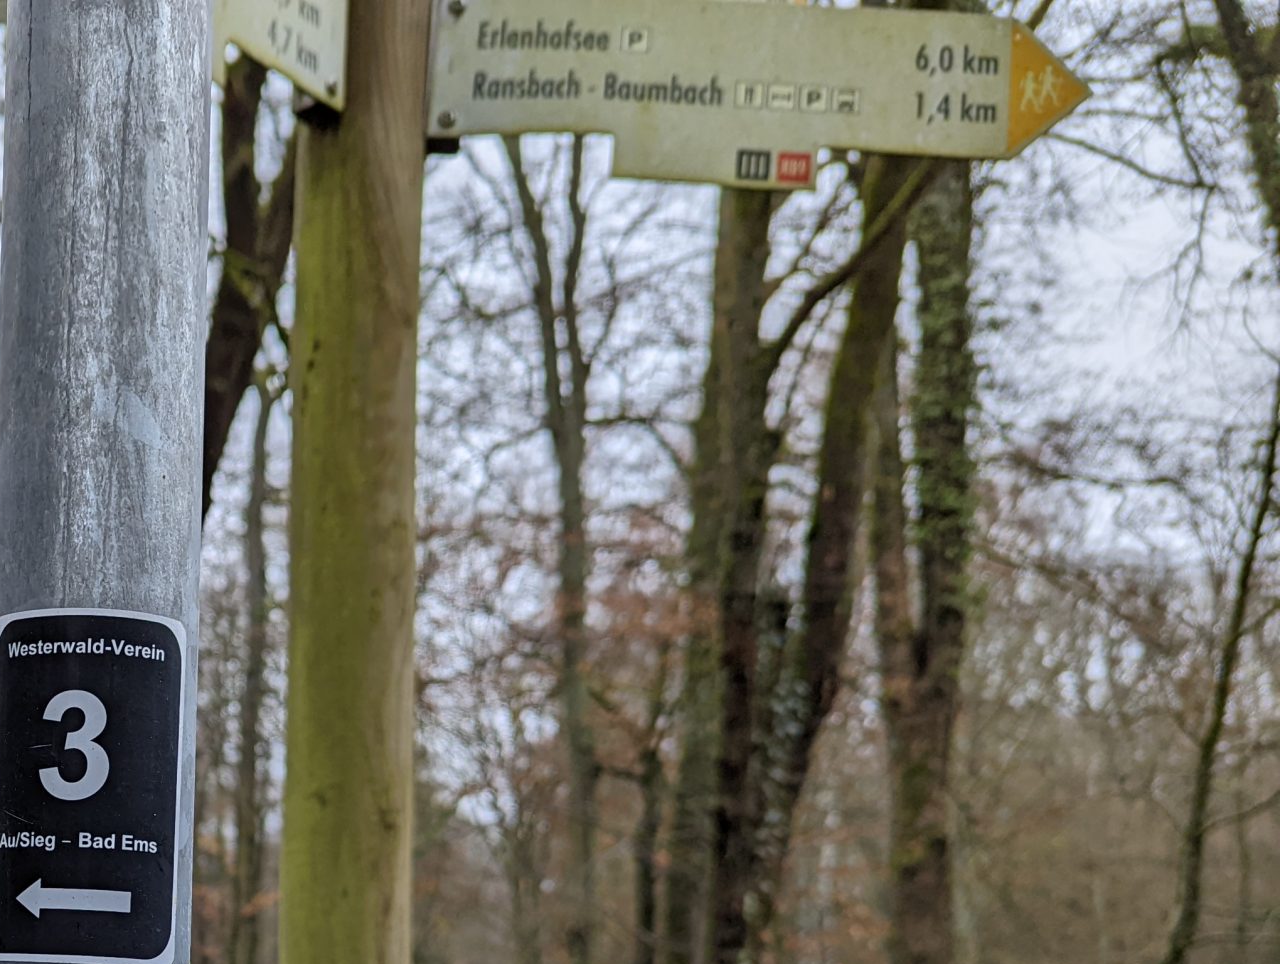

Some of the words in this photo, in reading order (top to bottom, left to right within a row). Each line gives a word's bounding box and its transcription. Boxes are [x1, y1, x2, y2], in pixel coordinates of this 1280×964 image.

[296, 33, 318, 73] km
[476, 20, 610, 53] Erlenhofsee
[914, 45, 956, 76] 6,0
[962, 48, 999, 77] km
[471, 71, 581, 102] Ransbach
[603, 76, 724, 108] Baumbach
[914, 92, 952, 123] 1,4
[960, 95, 999, 124] km
[7, 637, 166, 662] Westerwald-Verein
[38, 689, 110, 802] 3
[0, 831, 56, 851] Au/Sieg
[78, 832, 116, 850] Bad
[121, 834, 158, 854] Ems
